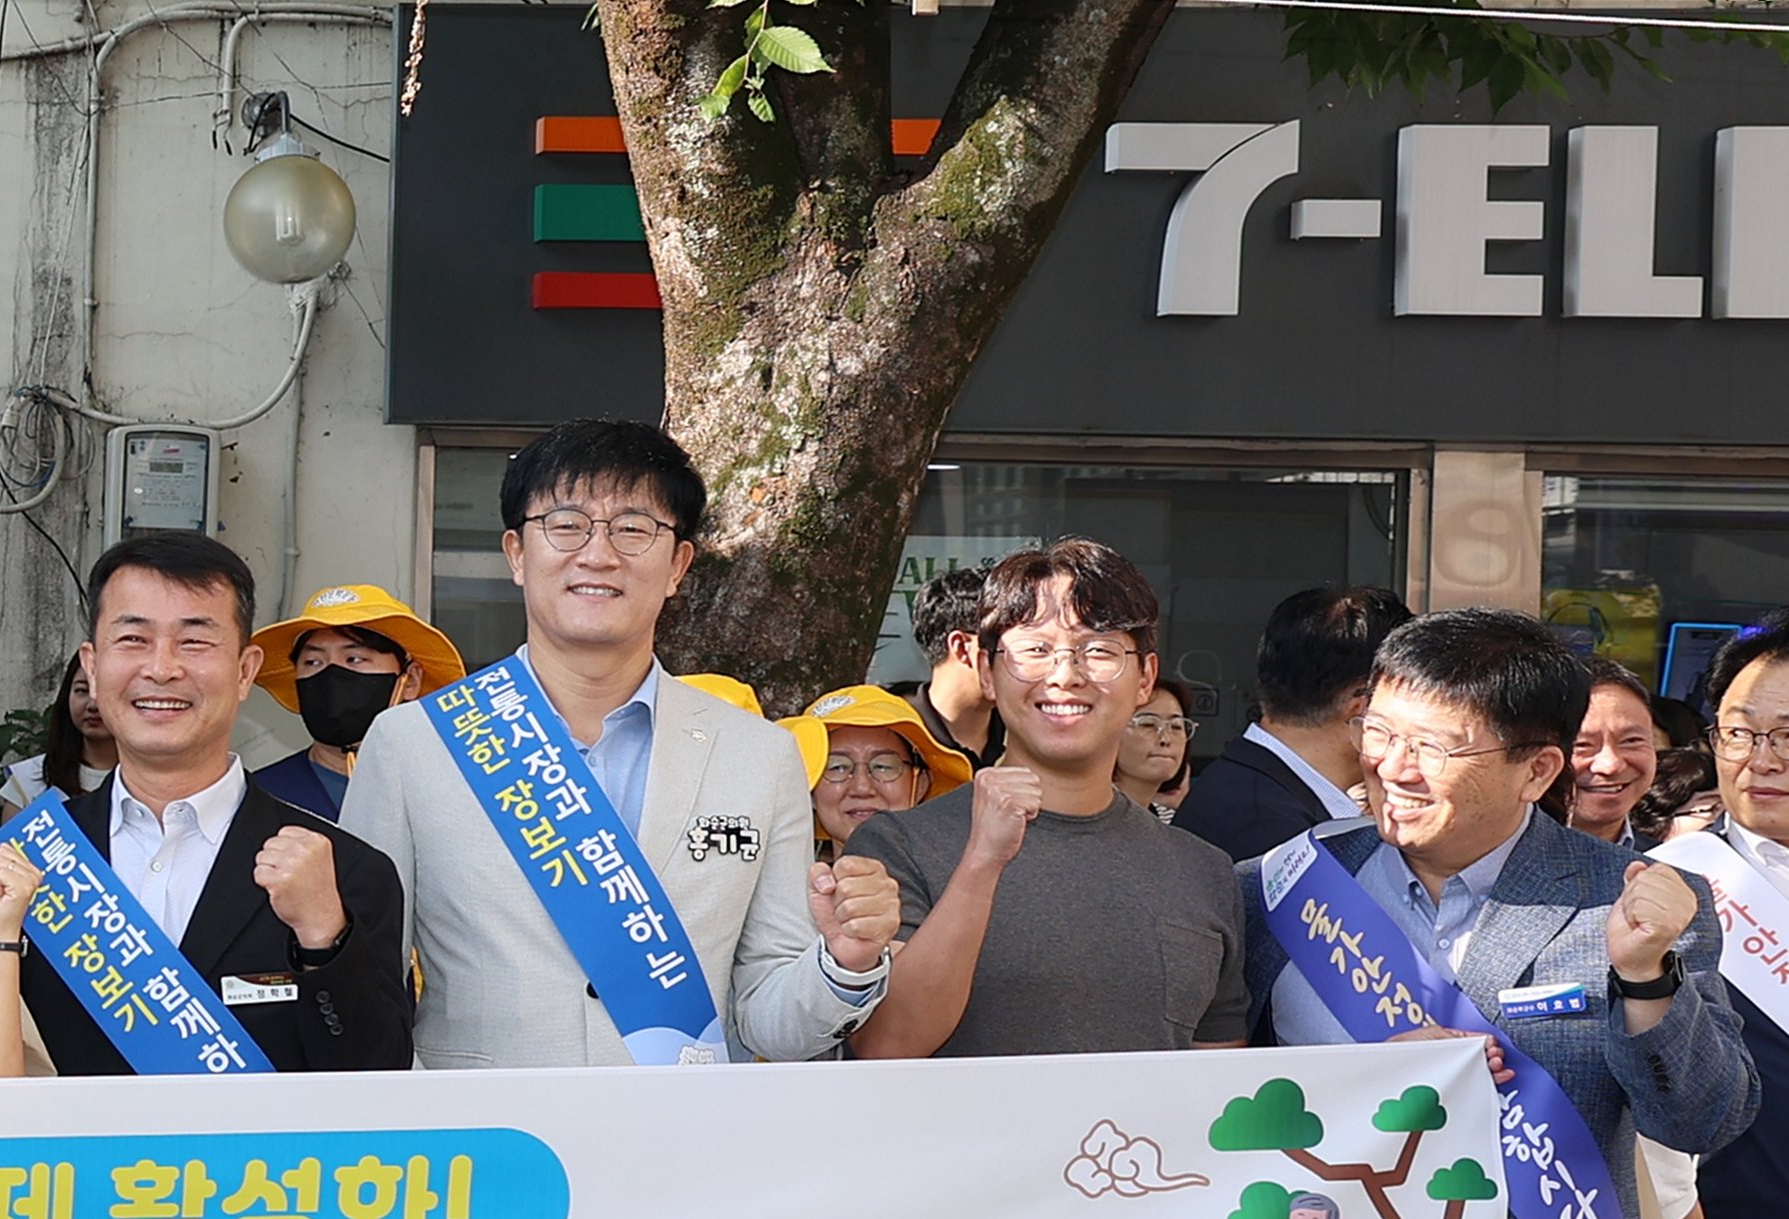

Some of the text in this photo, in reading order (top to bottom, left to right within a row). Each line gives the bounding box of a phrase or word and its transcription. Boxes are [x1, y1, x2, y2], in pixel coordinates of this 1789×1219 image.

[436, 685, 589, 888] 따뜻한 장보기
[474, 666, 689, 991] 전통시장과 함께하는
[688, 827, 759, 860] 홍기균
[22, 809, 154, 967] 전통시장과
[63, 932, 159, 1032] 장보기
